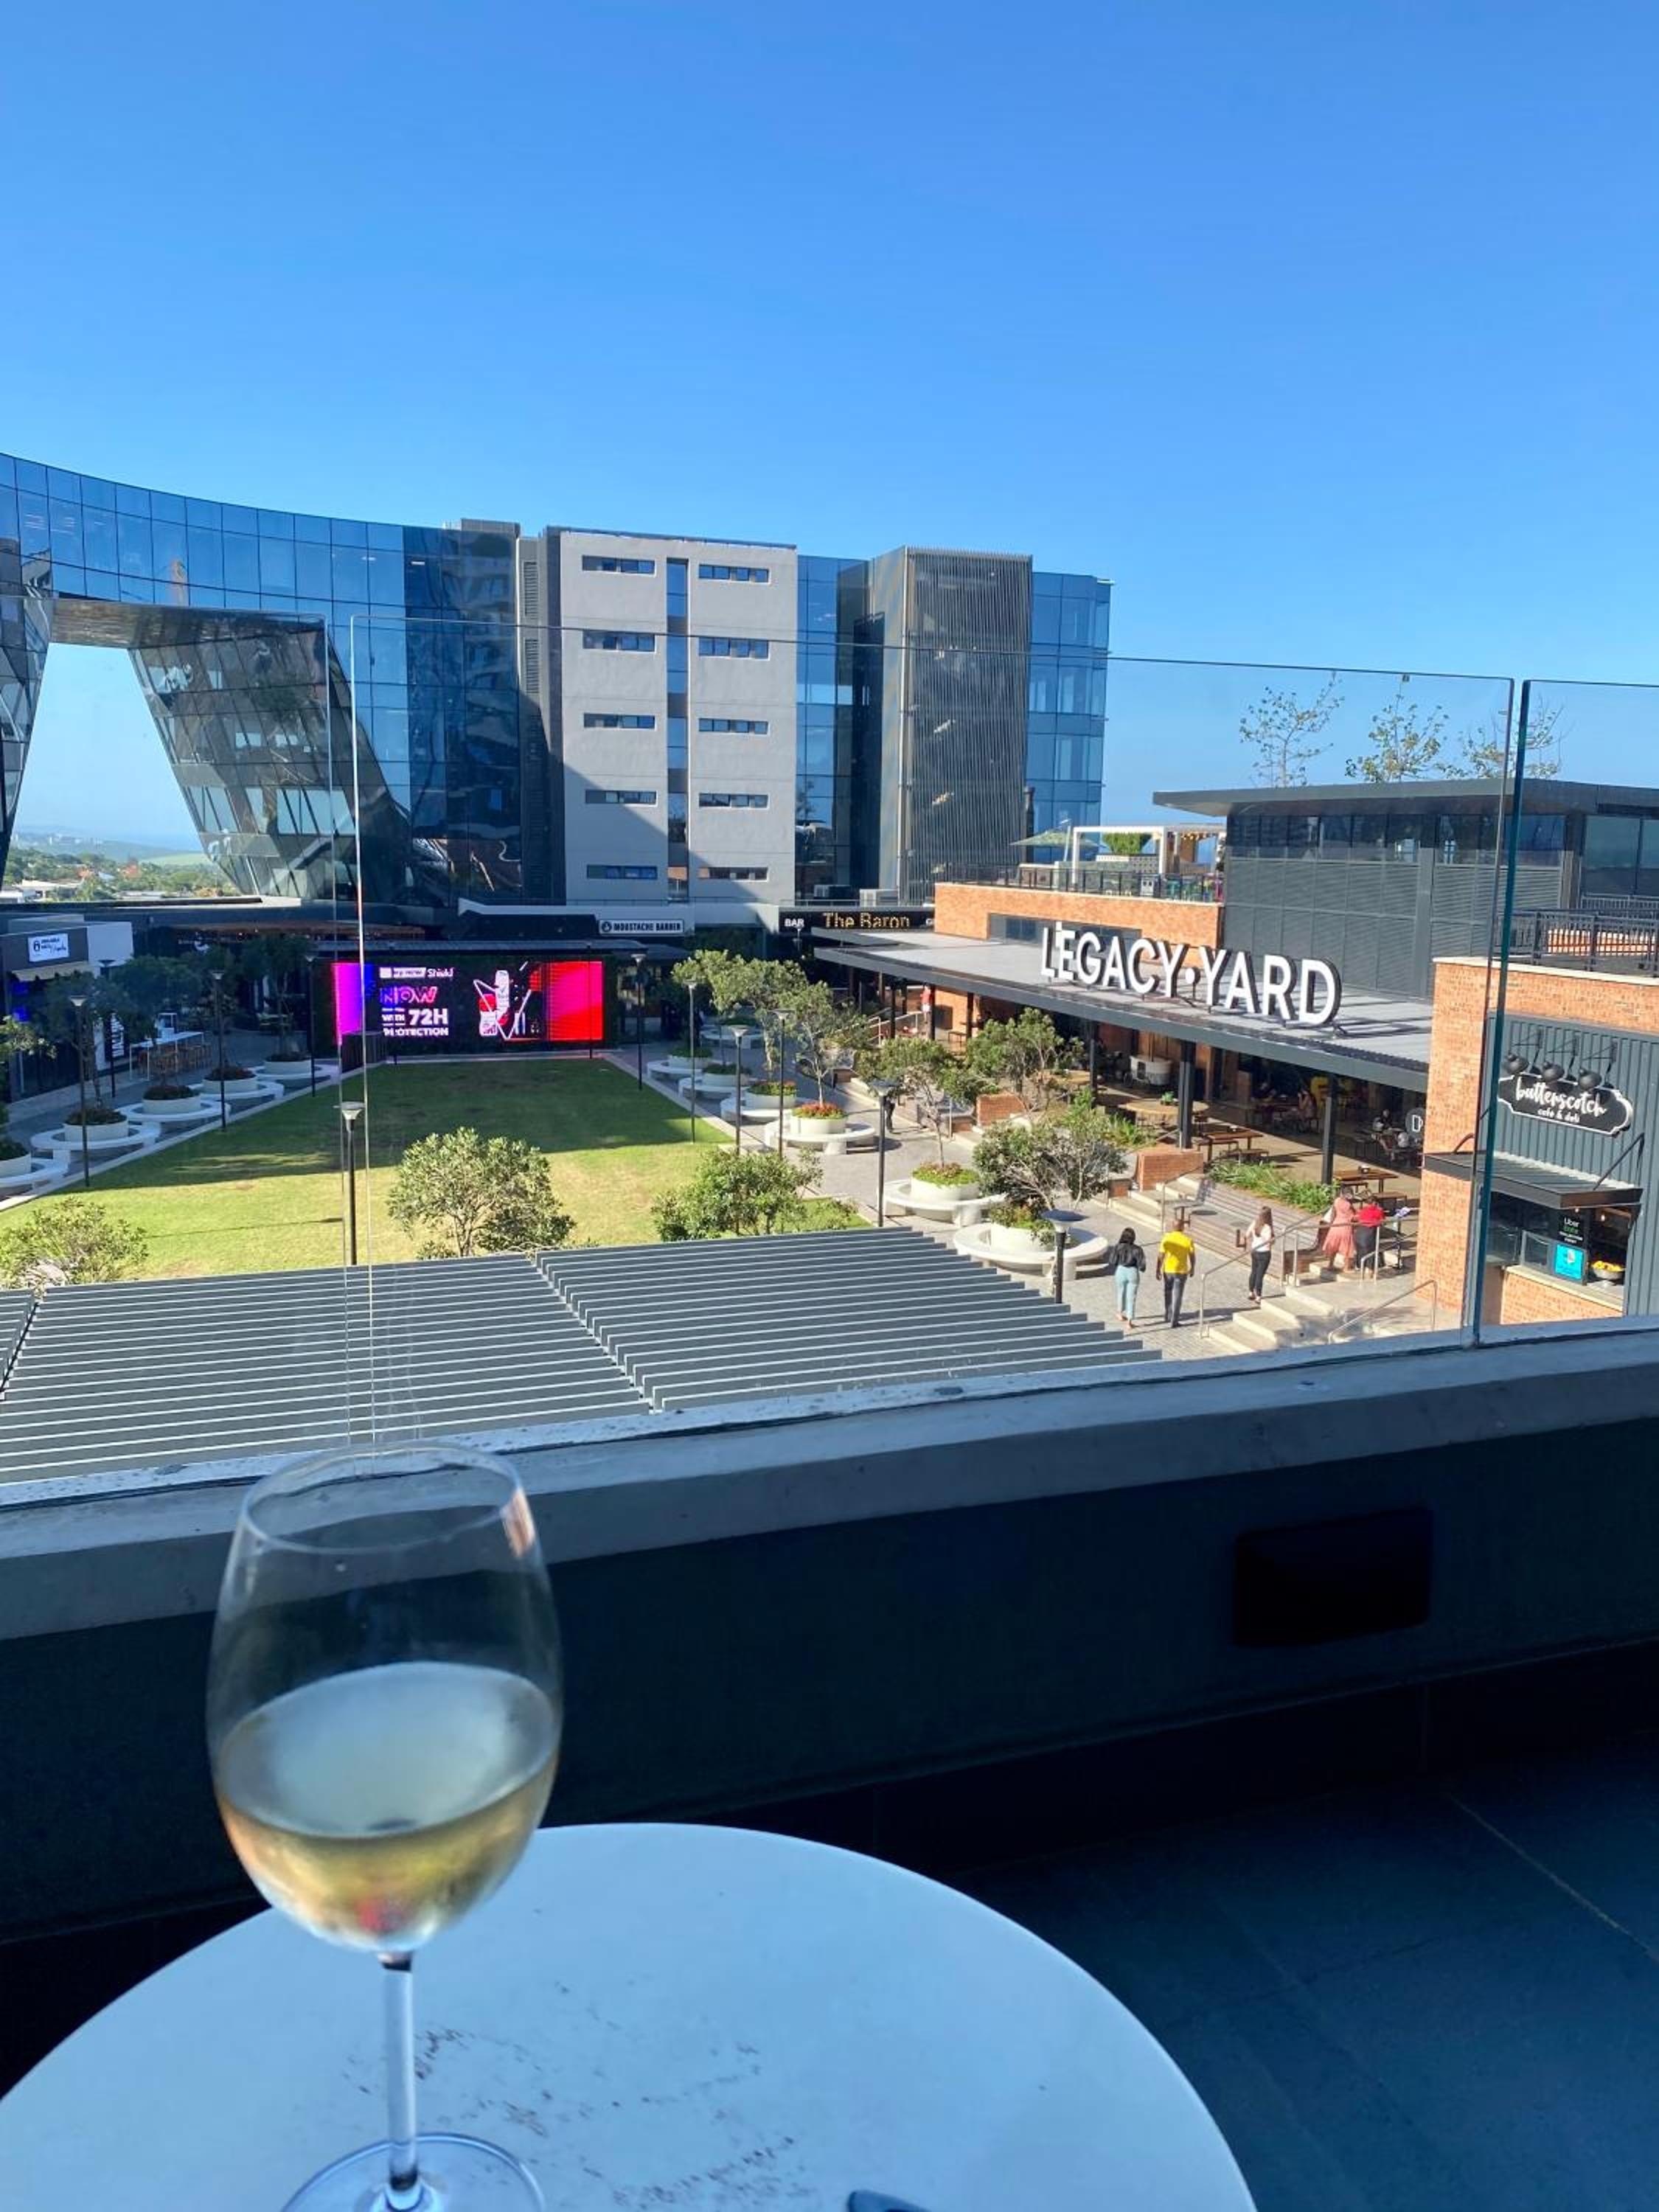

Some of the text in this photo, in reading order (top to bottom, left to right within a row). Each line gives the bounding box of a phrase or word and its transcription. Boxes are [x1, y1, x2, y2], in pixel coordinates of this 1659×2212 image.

[613, 922, 654, 931] MOUSTACHE
[785, 918, 804, 928] BAR
[823, 912, 855, 928] The
[860, 912, 910, 929] Baron
[1040, 923, 1342, 1027] LEGACY YARD
[408, 1007, 448, 1026] 72H
[383, 1027, 449, 1037] PROTECTION
[1515, 1076, 1607, 1117] butterscotch
[1564, 1217, 1579, 1227] Uber
